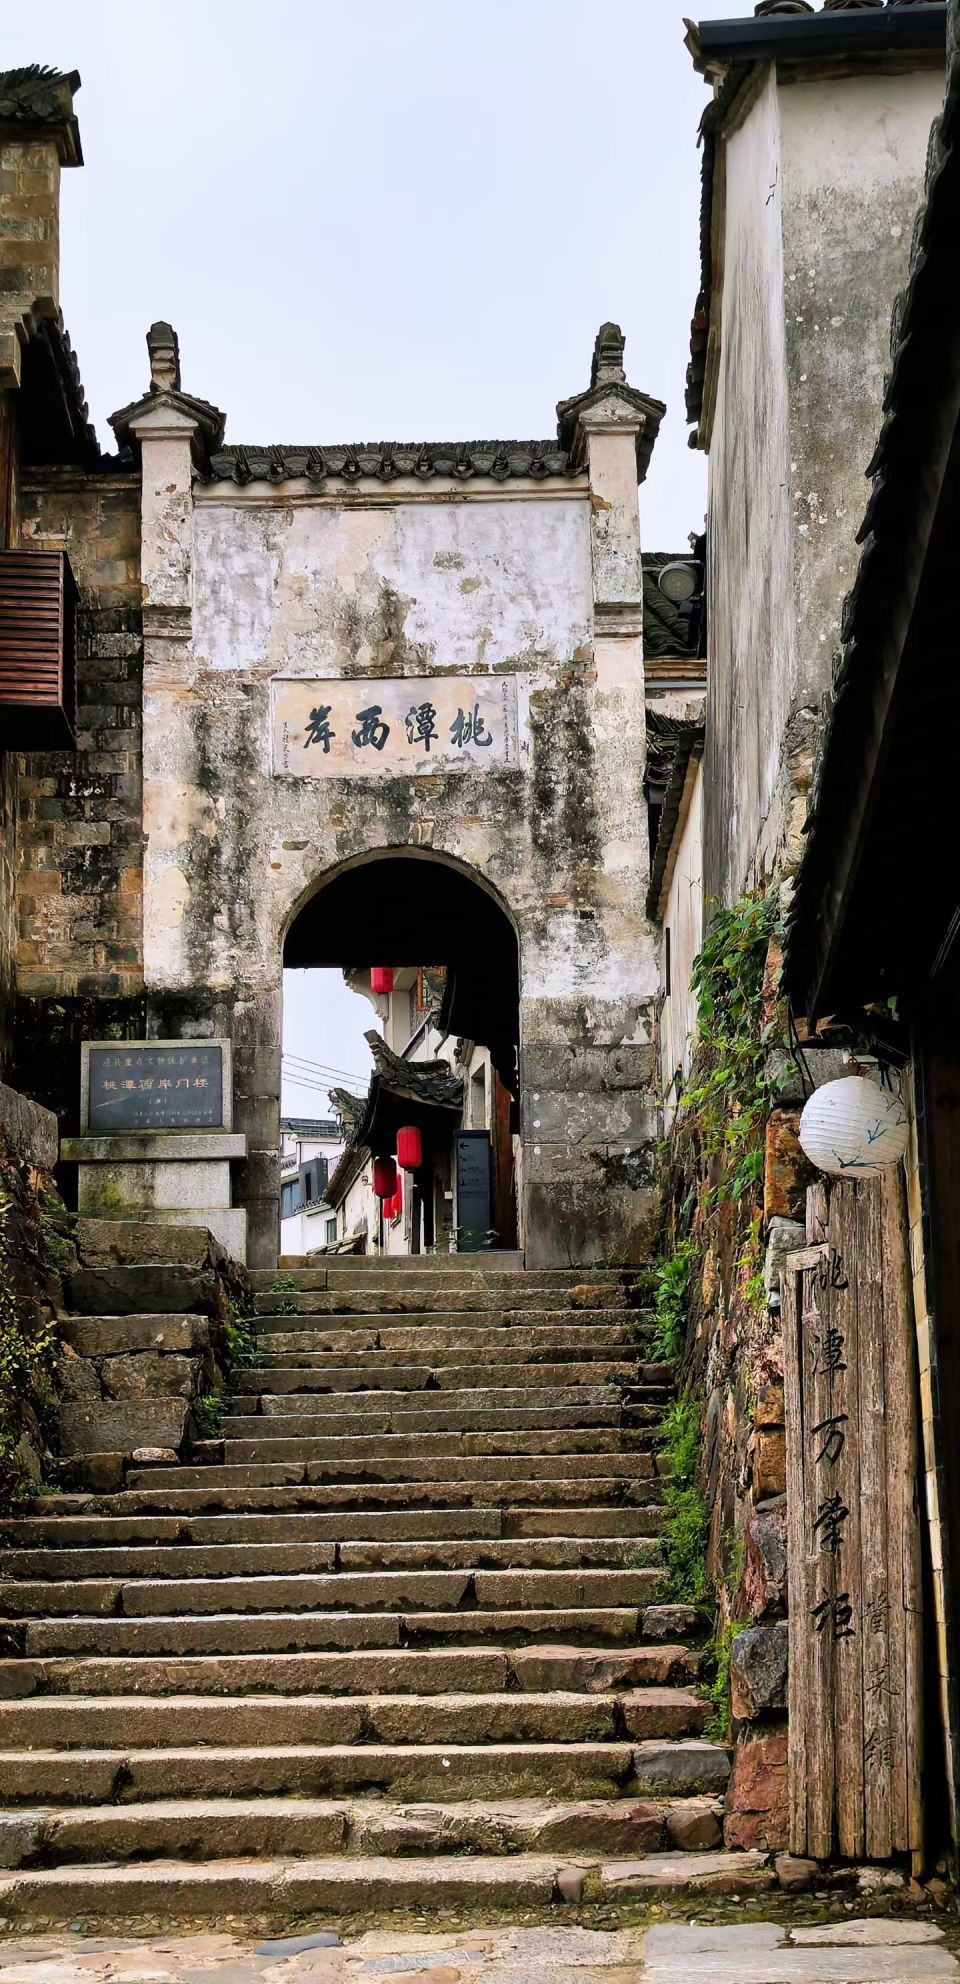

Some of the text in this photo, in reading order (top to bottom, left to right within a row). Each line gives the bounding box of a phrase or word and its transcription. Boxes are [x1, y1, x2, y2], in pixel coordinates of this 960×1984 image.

[303, 702, 493, 753] 桃潭西岸
[102, 1078, 209, 1090] 桃潭西岸门楼
